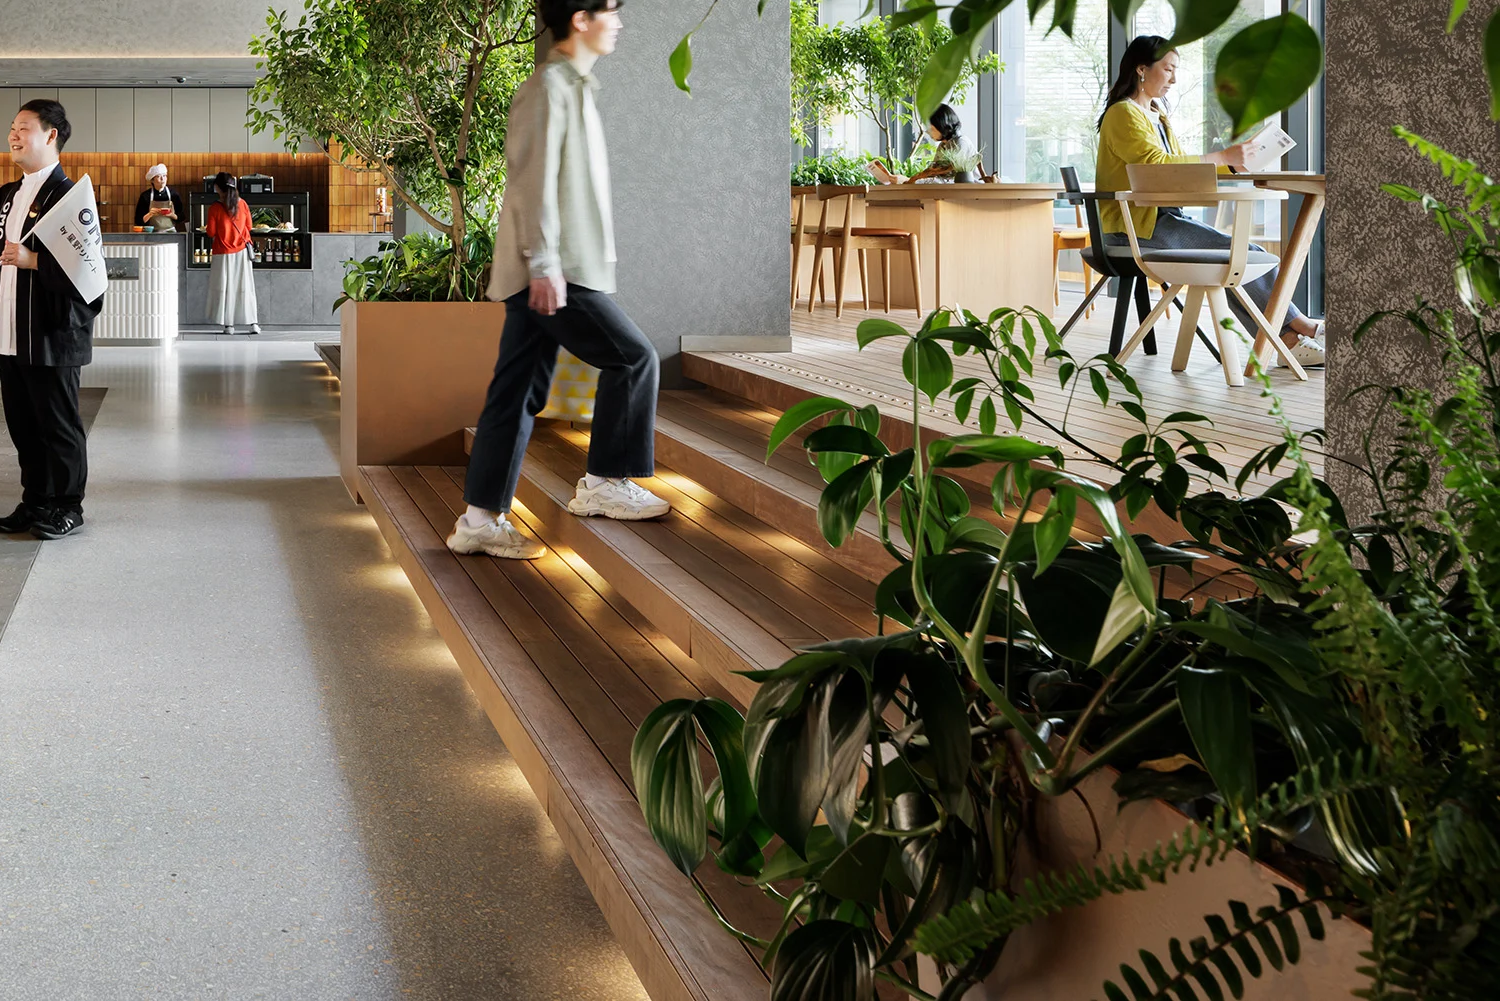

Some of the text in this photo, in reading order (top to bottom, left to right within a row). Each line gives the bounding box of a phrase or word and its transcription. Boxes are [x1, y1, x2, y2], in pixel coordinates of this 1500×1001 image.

[59, 225, 98, 274] by 星野リゾート
